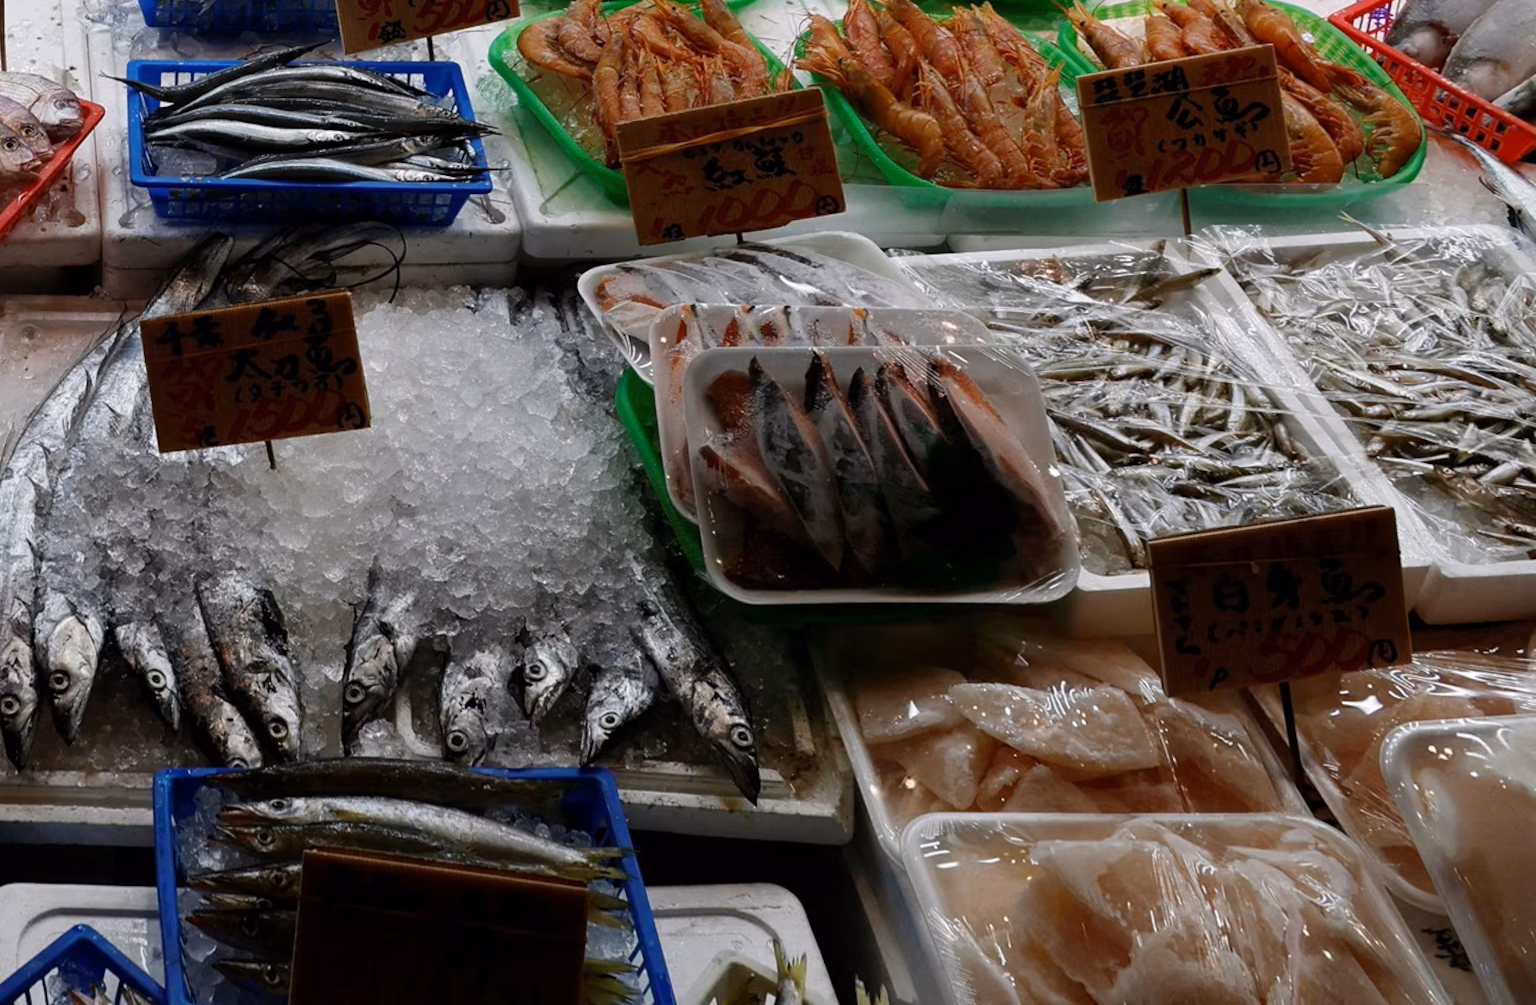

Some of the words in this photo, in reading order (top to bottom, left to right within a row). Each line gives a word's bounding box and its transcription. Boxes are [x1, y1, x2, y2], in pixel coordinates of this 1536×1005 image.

[1093, 65, 1190, 104] 琵琶湖
[224, 334, 359, 383] 太刀魚
